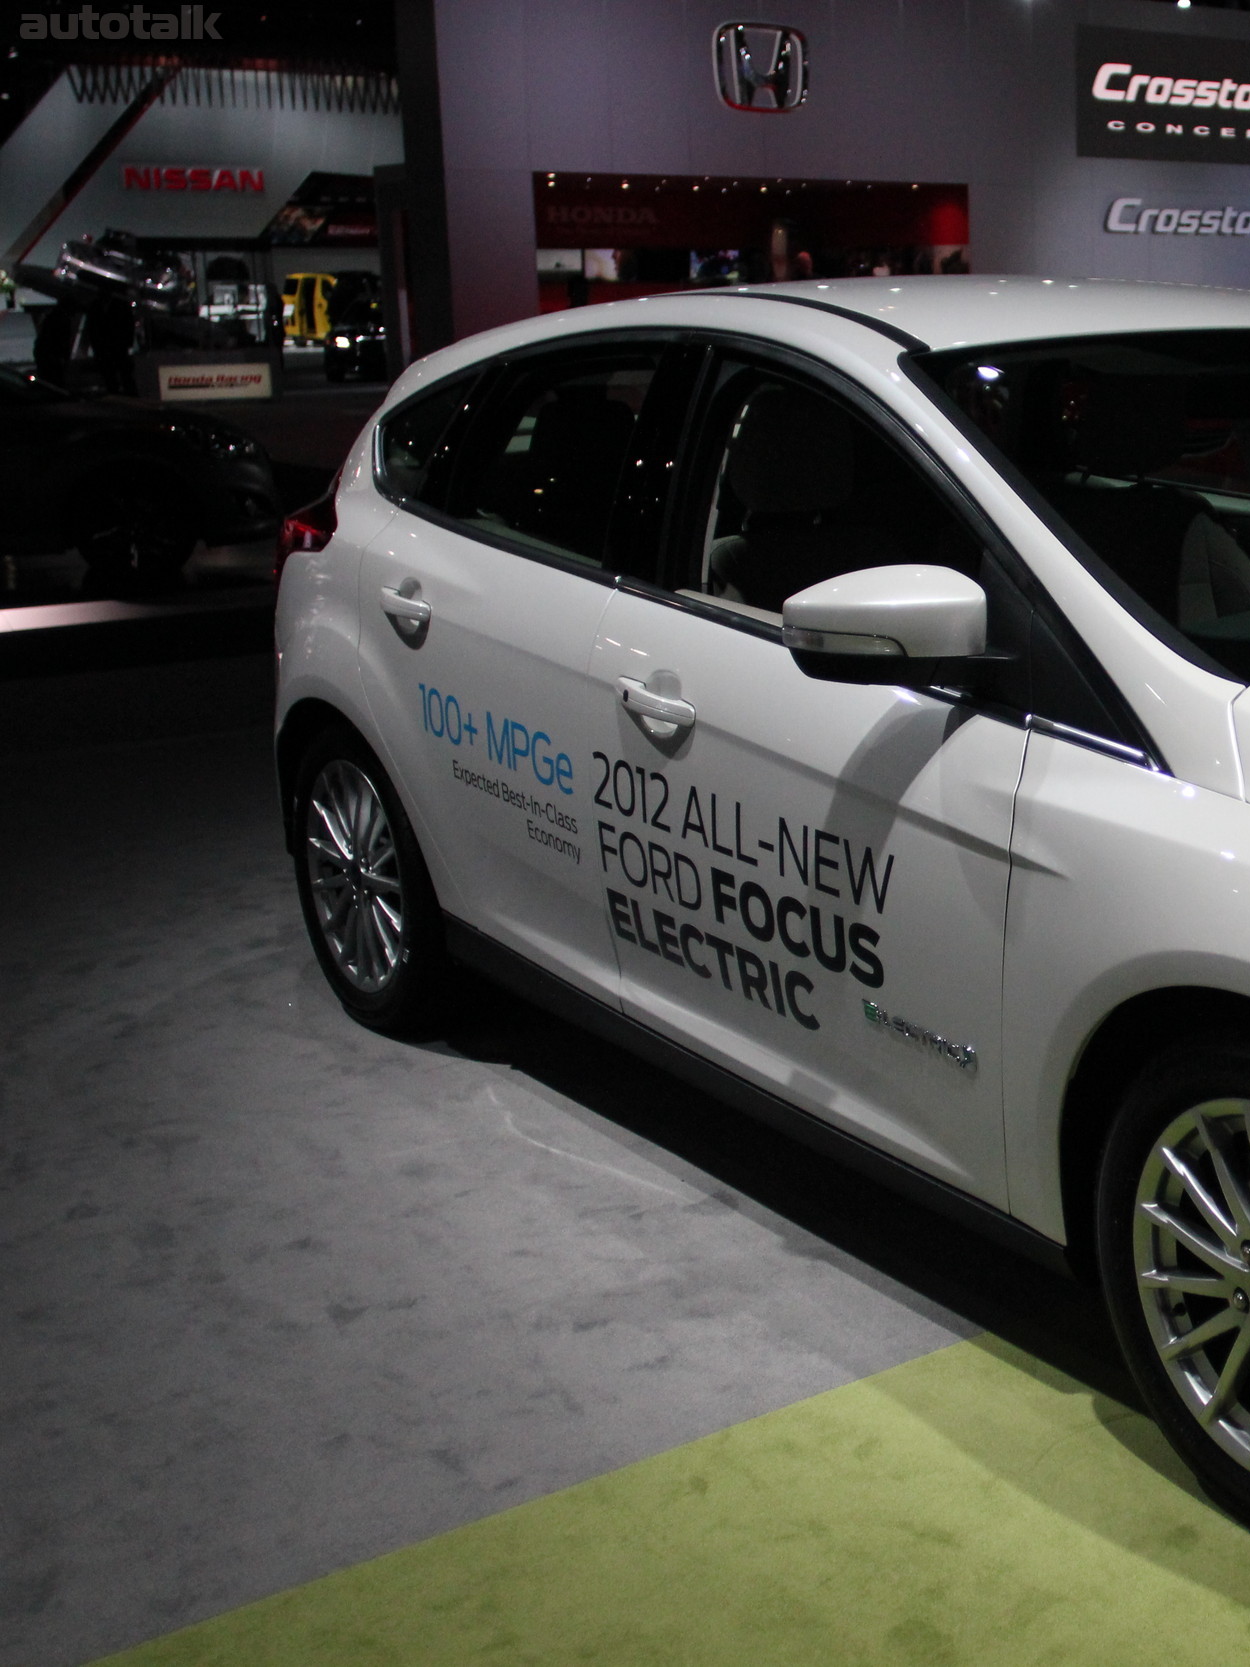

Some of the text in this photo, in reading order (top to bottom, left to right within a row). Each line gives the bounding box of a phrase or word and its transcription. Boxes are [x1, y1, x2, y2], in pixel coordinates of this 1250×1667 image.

[123, 166, 265, 192] NISSAN
[546, 205, 658, 224] HONDA
[418, 683, 574, 795] 100+ MPGe
[452, 759, 578, 834] Expected Best-In-Class
[527, 819, 581, 865] Economy
[592, 751, 895, 915] 2012 ALL-NEW
[598, 819, 884, 989] FORD FOCUS
[606, 887, 821, 1031] ELECTRIC
